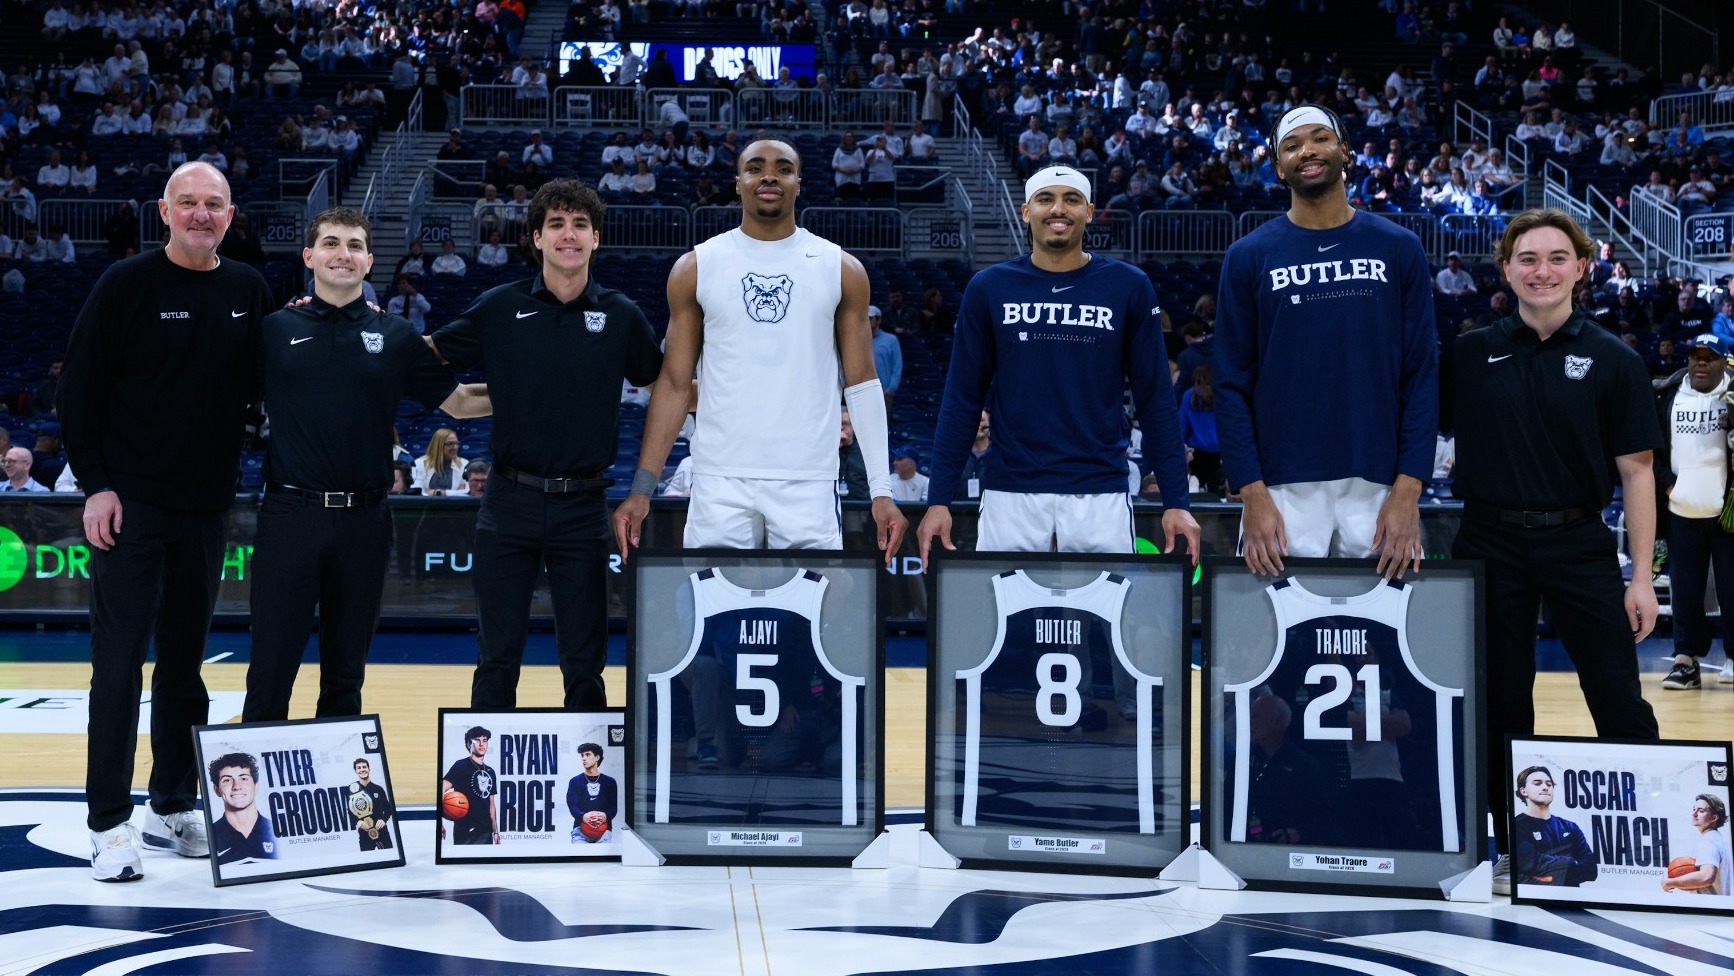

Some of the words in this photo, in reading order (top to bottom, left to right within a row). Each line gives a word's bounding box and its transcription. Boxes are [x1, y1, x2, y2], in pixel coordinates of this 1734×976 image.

[684, 46, 746, 81] DWGS
[267, 225, 295, 241] 205
[422, 226, 450, 242] 206
[1694, 226, 1725, 243] 208
[1695, 219, 1725, 227] SECTION
[931, 232, 960, 248] 206
[1269, 258, 1389, 292] BUTLER
[1002, 302, 1114, 331] BUTLER
[739, 620, 778, 645] AJAYI
[1035, 619, 1081, 645] BUTLER
[1315, 628, 1368, 655] TRAORE
[735, 653, 780, 727] 5
[1035, 652, 1082, 727] 8
[1303, 663, 1381, 741] 21
[500, 734, 558, 775] RYAN
[261, 749, 317, 788] TYLER
[1563, 768, 1637, 812] OSCAR
[500, 780, 556, 832] RICE
[289, 837, 312, 845] BUTLER
[312, 834, 341, 843] MANAGER
[731, 832, 760, 840] Michael
[761, 832, 779, 841] Ajayi
[1034, 837, 1055, 846] Yame
[1056, 839, 1079, 848] Butler
[1591, 814, 1670, 867] NACH
[1315, 855, 1340, 865] Yohan
[1341, 857, 1368, 867] Traore
[1601, 867, 1628, 875] BUTLER
[1629, 868, 1664, 877] MANAGER
